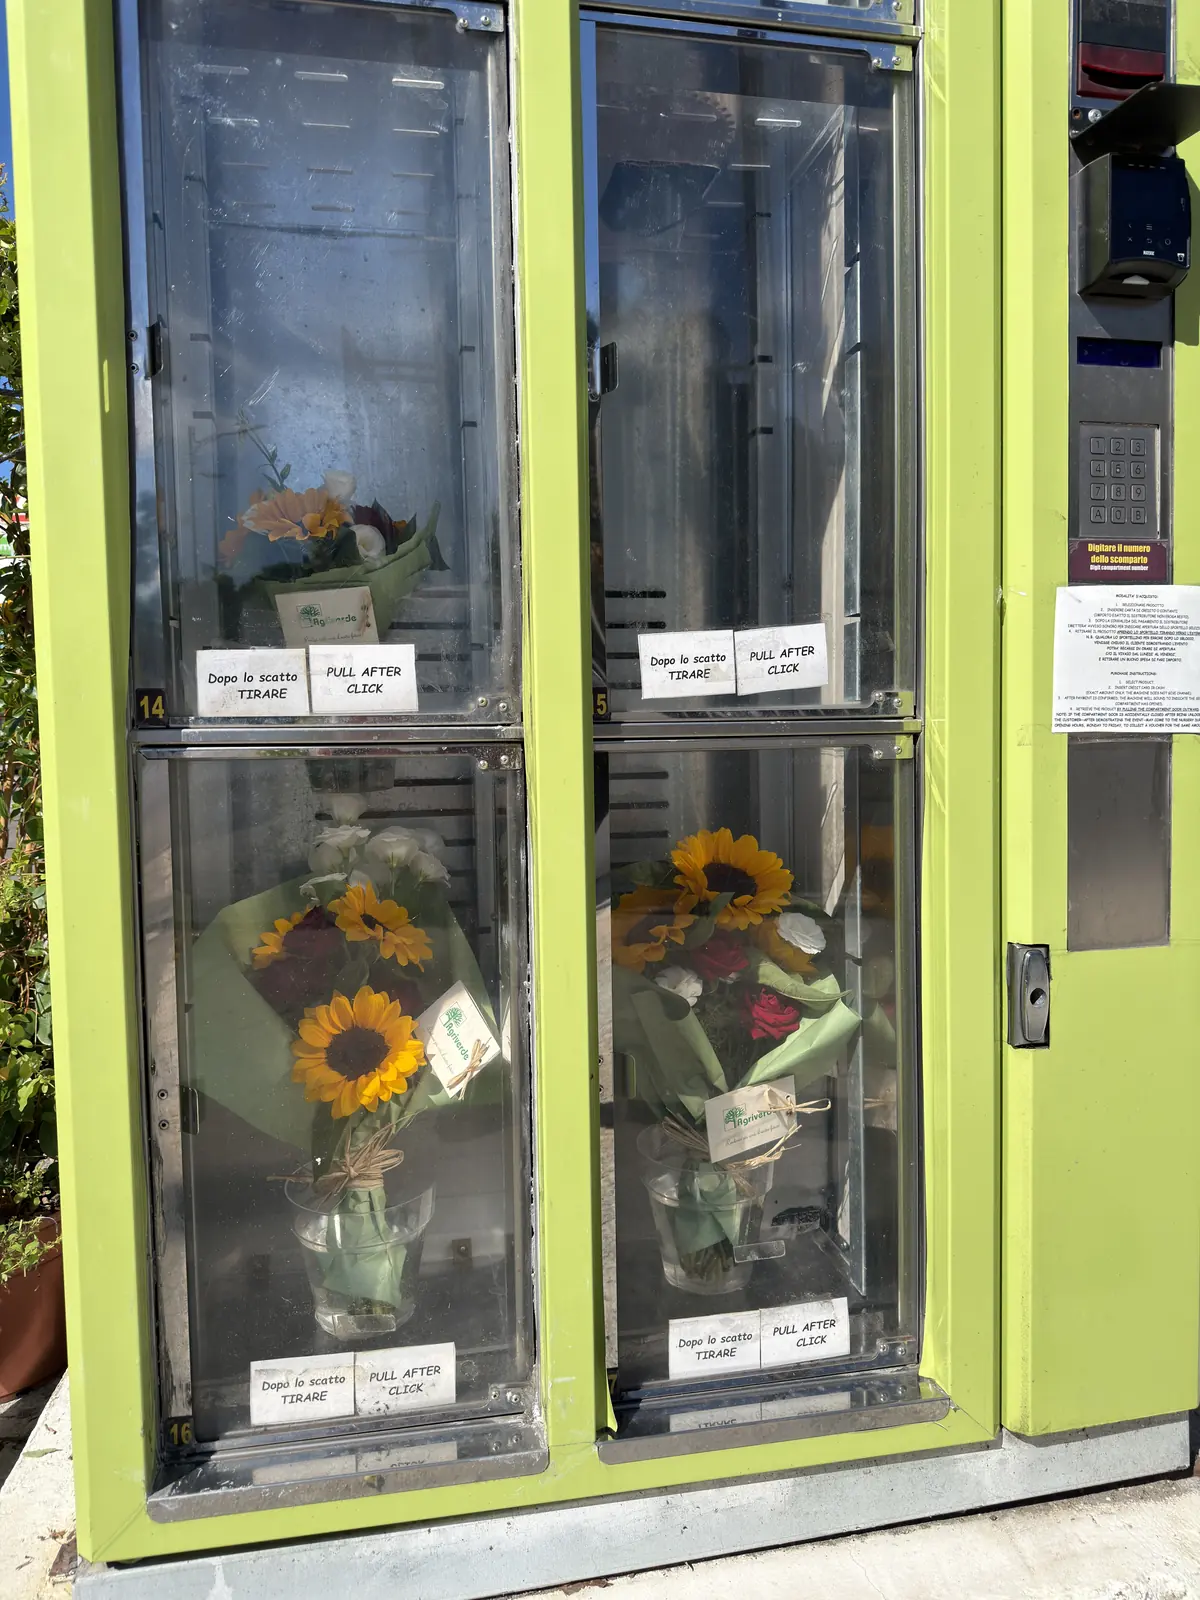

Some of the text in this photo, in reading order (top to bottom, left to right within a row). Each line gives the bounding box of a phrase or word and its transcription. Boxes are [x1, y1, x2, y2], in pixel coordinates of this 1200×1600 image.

[1096, 440, 1140, 452] 1 2 3
[1096, 464, 1102, 473] 4
[1135, 465, 1141, 474] 6
[1096, 486, 1141, 497] 7 8 9
[1095, 509, 1102, 520] A
[1136, 511, 1141, 520] B
[1088, 543, 1151, 553] Digitare il numero
[1091, 555, 1148, 564] dello scomparto
[750, 646, 815, 661] PULL AFTER
[651, 653, 726, 668] Dopo lo scatto
[327, 666, 401, 678] PULL AFTER
[669, 669, 711, 680] TIRARE
[767, 663, 799, 675] CLICK
[208, 672, 298, 686] Dopo lo scatto
[238, 688, 288, 699] TIRARE
[347, 683, 383, 694] CLICK
[140, 695, 164, 718] 14
[446, 1022, 469, 1060] Agriverde
[773, 1319, 836, 1336] PULL AFTER
[678, 1333, 752, 1348] Dopo lo scatto
[796, 1335, 827, 1347] CLICK
[696, 1348, 737, 1360] TIRARE
[369, 1365, 441, 1382] PULL AFTER
[262, 1375, 345, 1392] Dopo lo scatto
[388, 1383, 424, 1396] CLICK
[281, 1391, 328, 1404] TIRARE
[170, 1423, 192, 1444] 16
